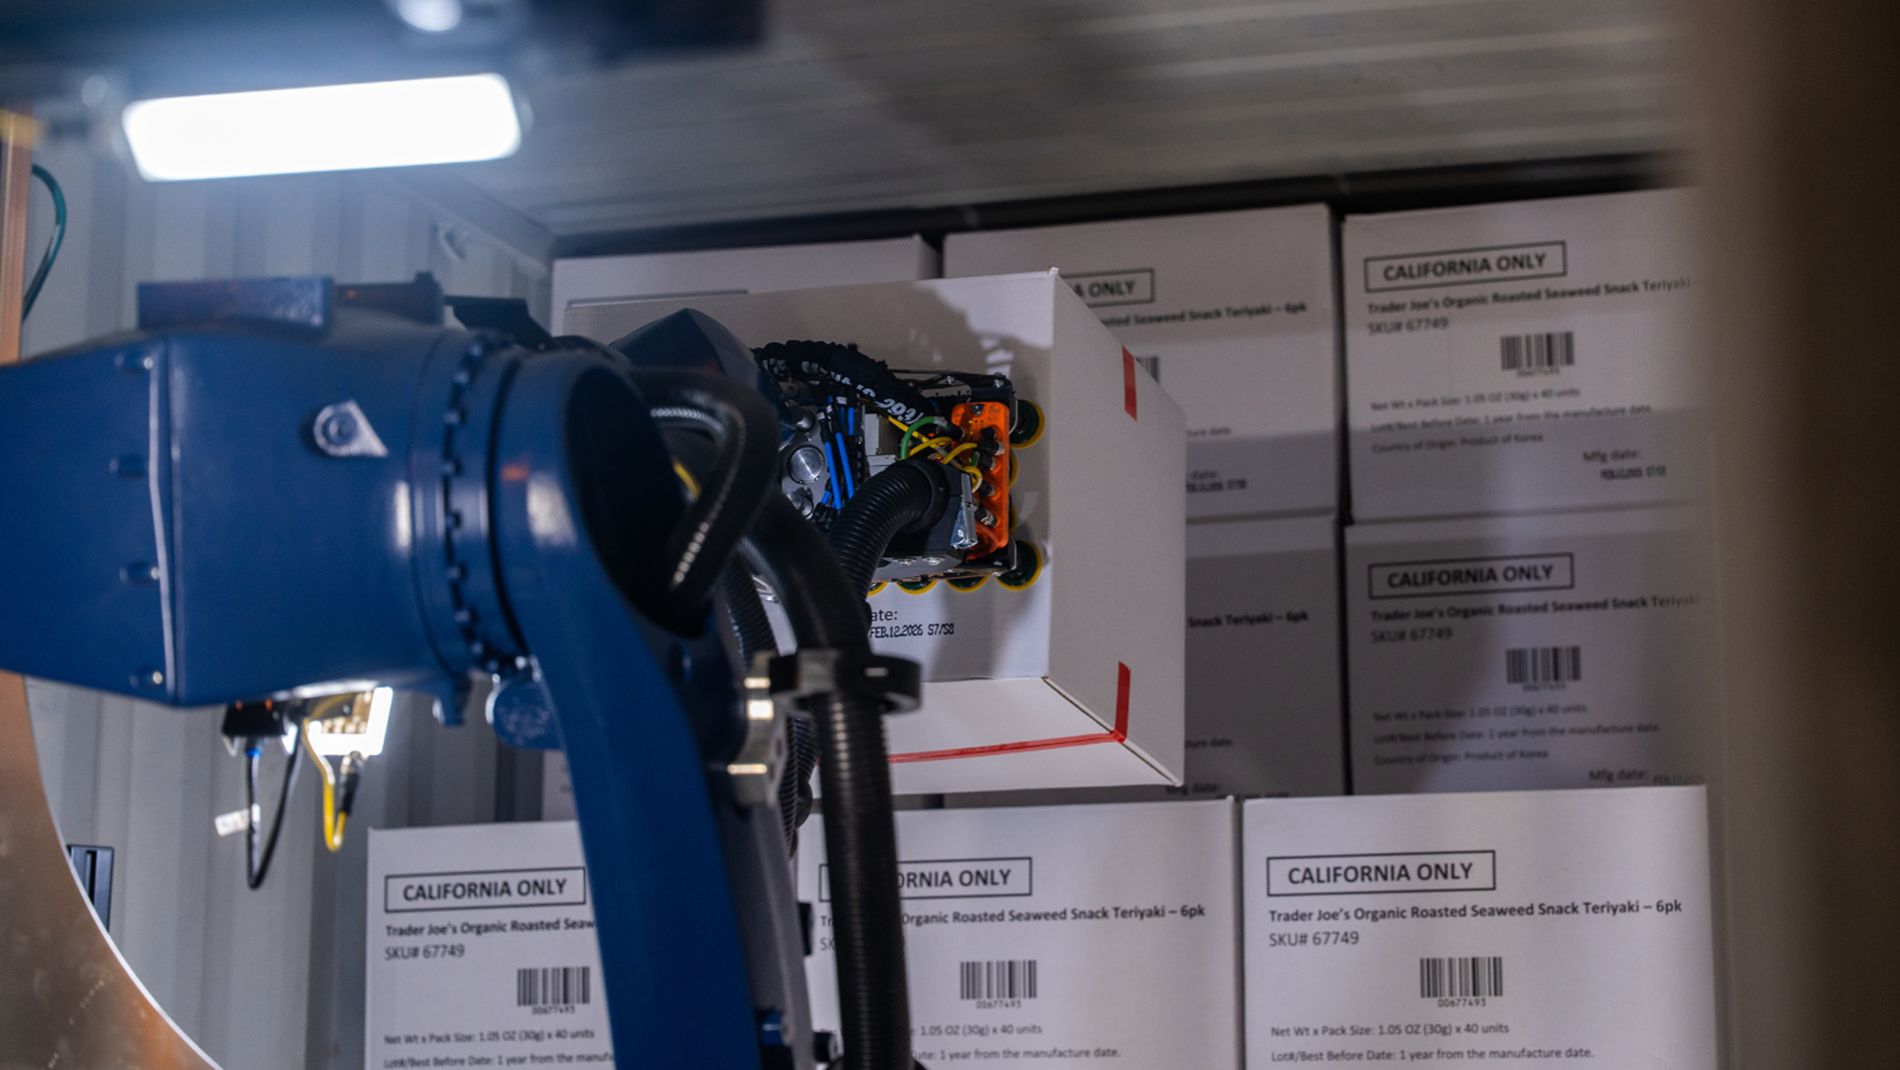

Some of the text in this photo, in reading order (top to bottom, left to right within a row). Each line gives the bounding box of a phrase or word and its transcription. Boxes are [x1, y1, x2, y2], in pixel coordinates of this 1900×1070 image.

[1384, 254, 1546, 281] CALIFORNIA ONLY
[1088, 280, 1135, 298] ONLY
[1368, 301, 1407, 314] Trader
[1443, 294, 1489, 310] Organic
[1492, 290, 1541, 304] Roasted
[1545, 285, 1600, 300] Seaweed
[1603, 282, 1639, 295] Snack
[1134, 312, 1185, 326] Seaweed
[1189, 308, 1221, 321] Snack
[1225, 304, 1271, 317] Teriyaki
[1285, 300, 1307, 313] 6pk
[1389, 566, 1553, 588] CALIFORNIA ONLY
[871, 610, 898, 622] ate:
[1448, 605, 1495, 620] Organic
[1499, 602, 1548, 616] Roasted
[1552, 599, 1607, 612] Seaweed
[1610, 597, 1646, 609] Snack
[959, 870, 1011, 887] ONLY
[1288, 863, 1473, 884] CALIFORNIA ONLY
[403, 879, 565, 901] CALIFORNIA ONLY
[953, 910, 1005, 924] Roasted
[1008, 908, 1067, 922] Seaweed
[1071, 907, 1109, 920] Snack
[1112, 905, 1166, 920] Teriyaki
[1180, 905, 1205, 919] 6pk
[1269, 909, 1313, 922] Trader
[1317, 908, 1350, 921] Joe's
[1354, 907, 1407, 922] Organic
[1411, 905, 1467, 919] Roasted
[1471, 903, 1534, 917] Seaweed
[1538, 902, 1579, 915] Snack
[1583, 900, 1640, 916] Teriyaki
[1656, 900, 1682, 915] 6pk
[386, 924, 425, 937] Trader
[428, 923, 457, 935] Joe's
[460, 921, 507, 936] Organic
[510, 918, 560, 932] Roasted
[1269, 931, 1359, 947] SKU# 67749
[385, 944, 465, 960] SKU# 67749
[921, 1026, 942, 1034] 1.05
[945, 1025, 959, 1034] OZ
[963, 1024, 988, 1036] (30g)
[1000, 1025, 1013, 1033] 40
[1016, 1024, 1042, 1033] units
[1271, 1027, 1290, 1037] Net
[1293, 1026, 1310, 1036] Wt
[1322, 1025, 1346, 1036] Pack
[1349, 1025, 1374, 1035] Size:
[1379, 1025, 1401, 1034] 1.05
[1405, 1024, 1420, 1034] OZ
[1424, 1023, 1451, 1036] (30g)
[1464, 1024, 1478, 1033] 40
[1481, 1023, 1509, 1033] units
[948, 1052, 971, 1062] year
[974, 1049, 1000, 1058] from
[1002, 1049, 1020, 1058] the
[1023, 1048, 1091, 1058] manufacture
[1093, 1047, 1120, 1057] date.
[1327, 1050, 1363, 1060] Before
[1367, 1050, 1396, 1060] Date:
[1409, 1052, 1433, 1063] year
[1437, 1049, 1464, 1059] from
[1467, 1049, 1486, 1059] the
[1489, 1048, 1562, 1059] manufacture
[1565, 1048, 1594, 1058] date.
